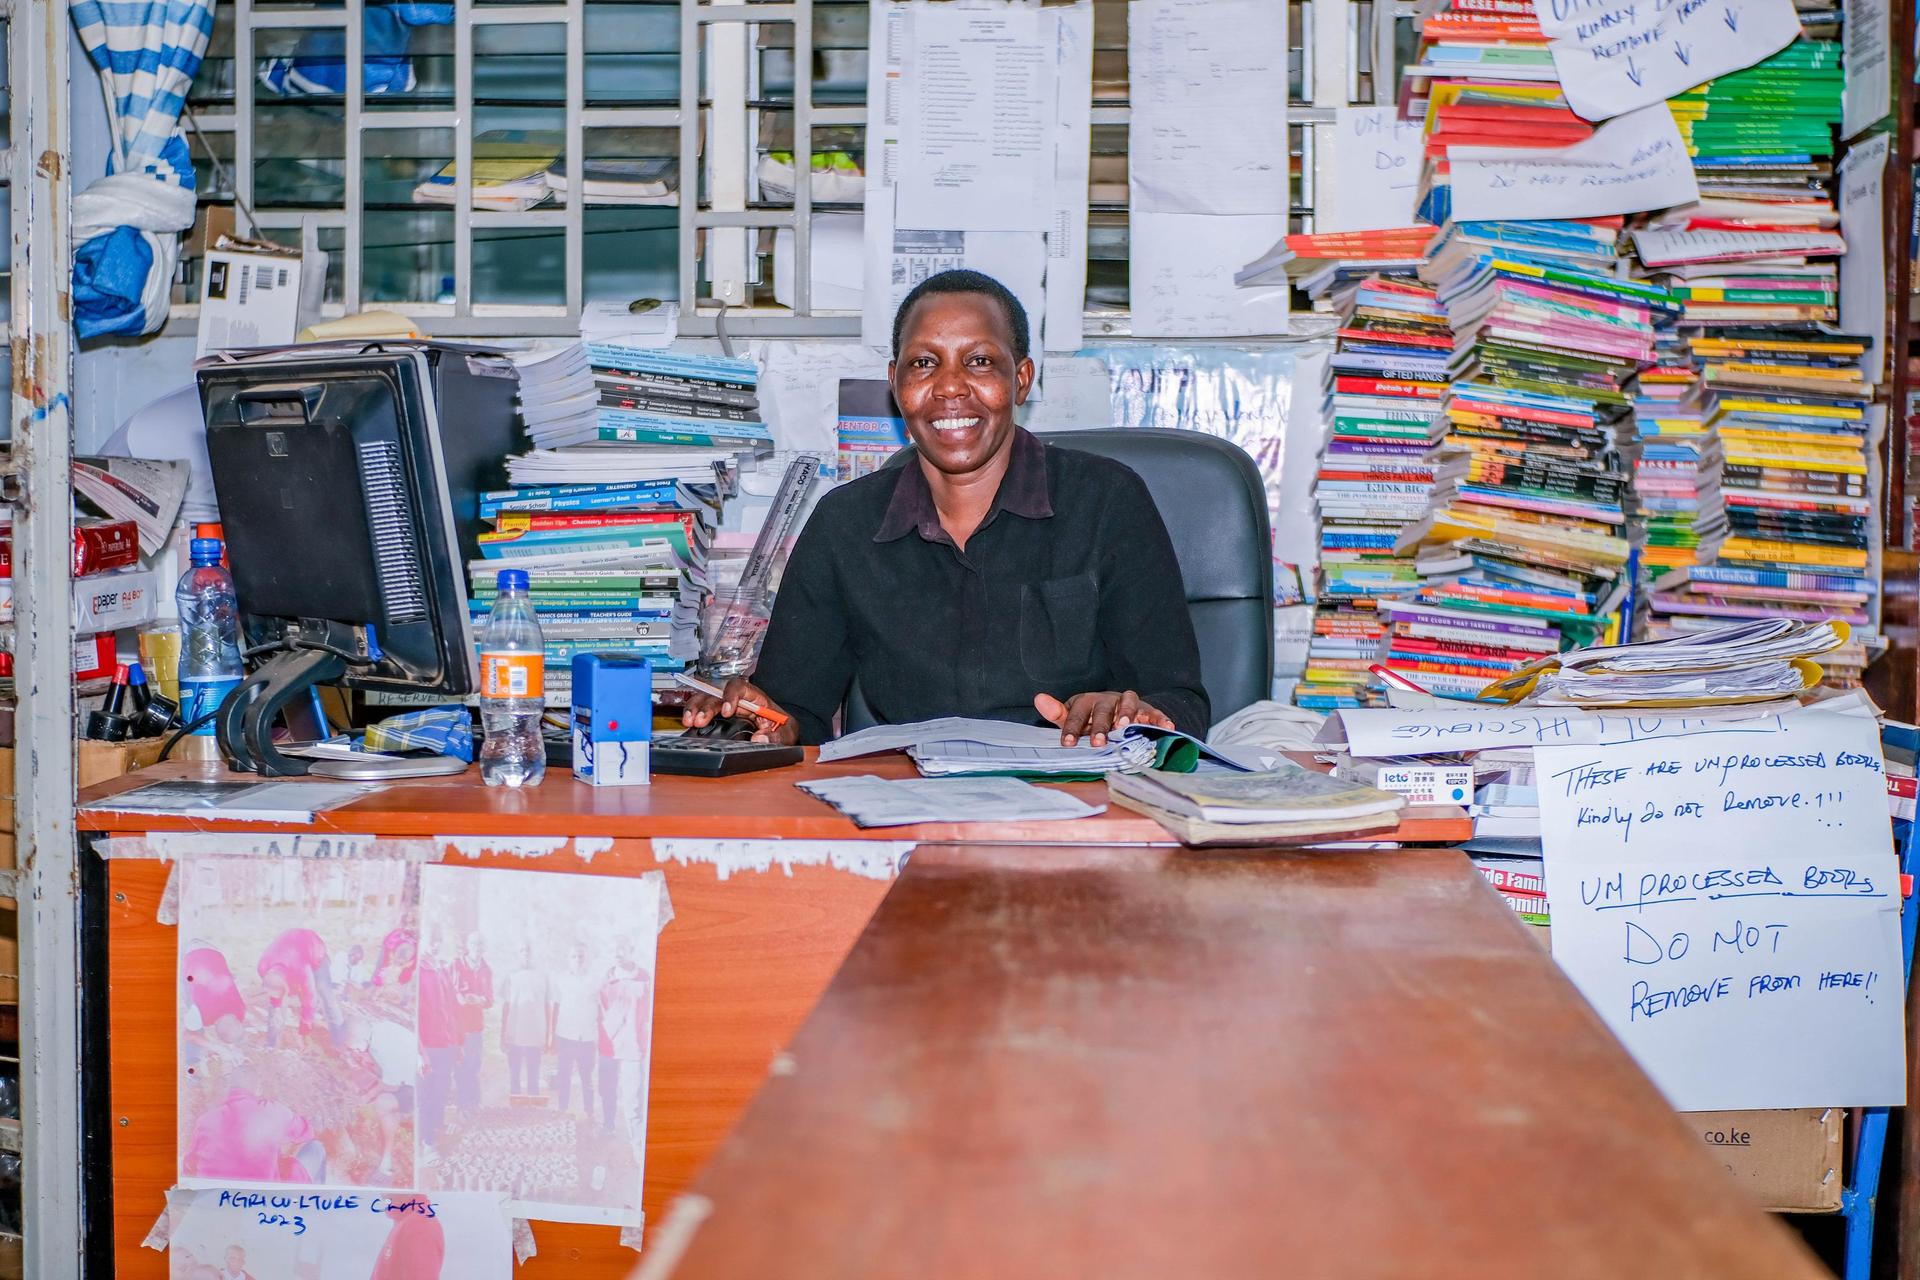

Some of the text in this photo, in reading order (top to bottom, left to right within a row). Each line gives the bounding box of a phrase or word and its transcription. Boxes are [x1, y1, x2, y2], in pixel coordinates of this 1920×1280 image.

[1382, 369, 1445, 382] GIFTED HANDS
[1403, 385, 1413, 393] of
[838, 420, 879, 432] MENTOR
[1370, 464, 1433, 474] DEEP WORK
[1362, 472, 1412, 481] THINGS FALL
[605, 483, 637, 491] CHEMISTRY
[1404, 484, 1424, 494] BIG
[529, 502, 548, 510] School
[553, 499, 580, 508] Physics
[590, 496, 616, 504] Learner's
[532, 519, 555, 527] Golden
[556, 519, 568, 527] Tips
[572, 518, 602, 526] Chemistry
[1430, 616, 1452, 625] CLOUD
[1453, 618, 1469, 626] THAT
[1470, 620, 1497, 631] TARRIED
[638, 627, 648, 636] 10
[1436, 643, 1509, 657] ANIMAL FARM
[1398, 653, 1512, 670] WHO WILL CRY WHEN YOU
[1418, 661, 1441, 671] How
[1458, 664, 1478, 675] Win
[1405, 672, 1493, 687] THE POWER OF POSITIV
[1432, 683, 1462, 693] DEEP
[1384, 773, 1410, 783] leto
[1551, 759, 1632, 797] THESE
[1645, 761, 1682, 776] ARE
[1576, 804, 1633, 843] Kindly
[1639, 801, 1665, 823] do
[1673, 804, 1704, 818] not
[1479, 869, 1504, 886] ade
[1623, 919, 1790, 965] DO NOT
[1631, 976, 1734, 1022] REMOVE
[1748, 974, 1801, 999] FROM
[1704, 1127, 1751, 1144] co.ke
[257, 1211, 307, 1236] 2023
